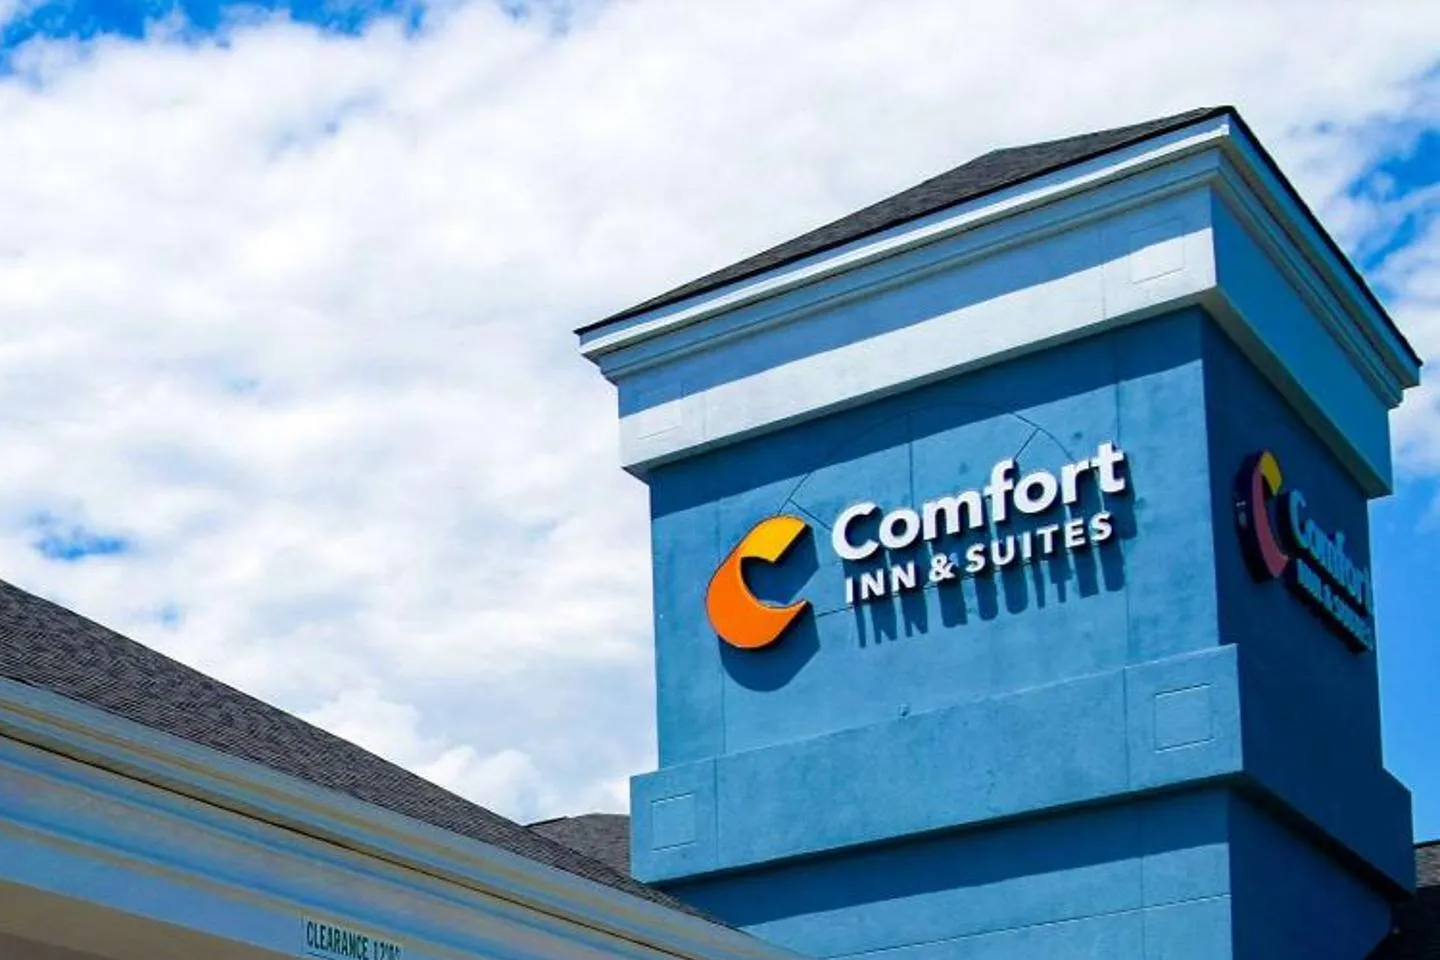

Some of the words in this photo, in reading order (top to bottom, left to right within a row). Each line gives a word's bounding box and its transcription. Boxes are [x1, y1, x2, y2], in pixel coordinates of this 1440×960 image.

[831, 441, 1126, 560] Comfort
[845, 560, 917, 604] INN
[929, 552, 956, 583] &
[964, 512, 1113, 573] SUITES
